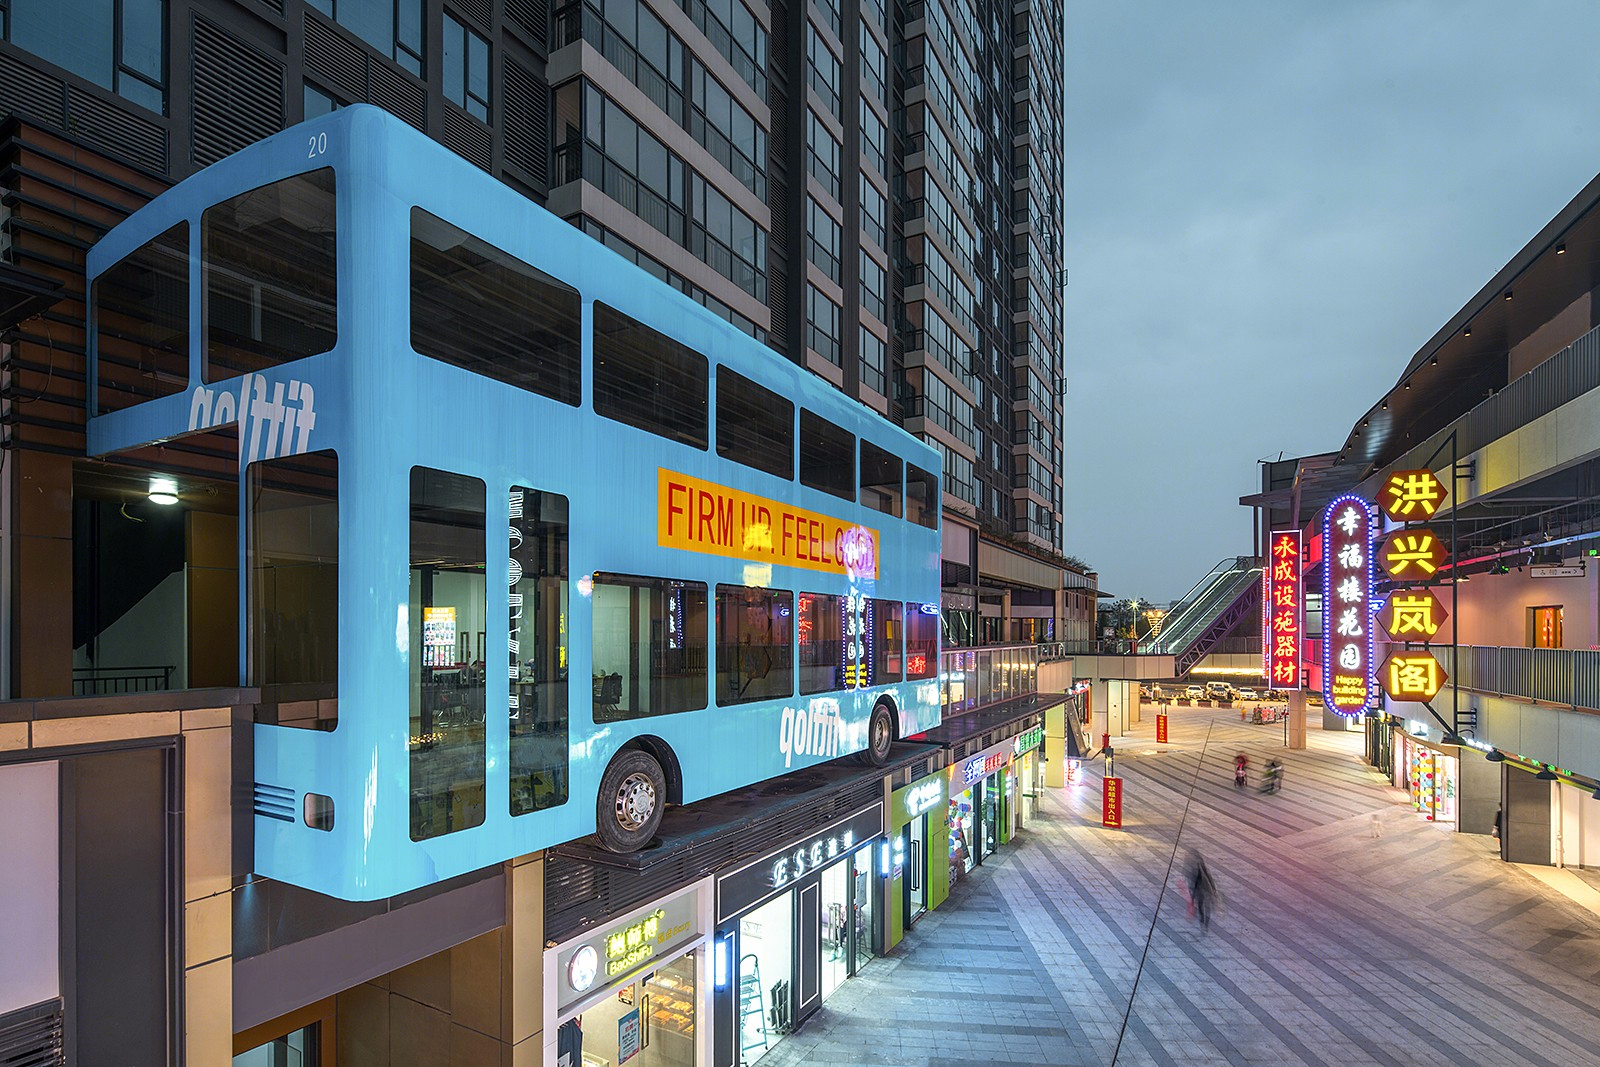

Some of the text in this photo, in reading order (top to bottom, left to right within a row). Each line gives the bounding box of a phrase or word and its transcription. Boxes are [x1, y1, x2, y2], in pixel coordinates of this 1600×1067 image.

[308, 132, 327, 159] 20
[667, 482, 734, 547] FIRM
[782, 513, 831, 564] FEEL
[1386, 473, 1438, 696] 洪兴岚阁
[1273, 536, 1298, 684] 永成设施器材
[1332, 684, 1367, 696] building
[1335, 675, 1364, 687] Happy
[1334, 695, 1365, 706] garden
[607, 944, 653, 976] BaoShiFu
